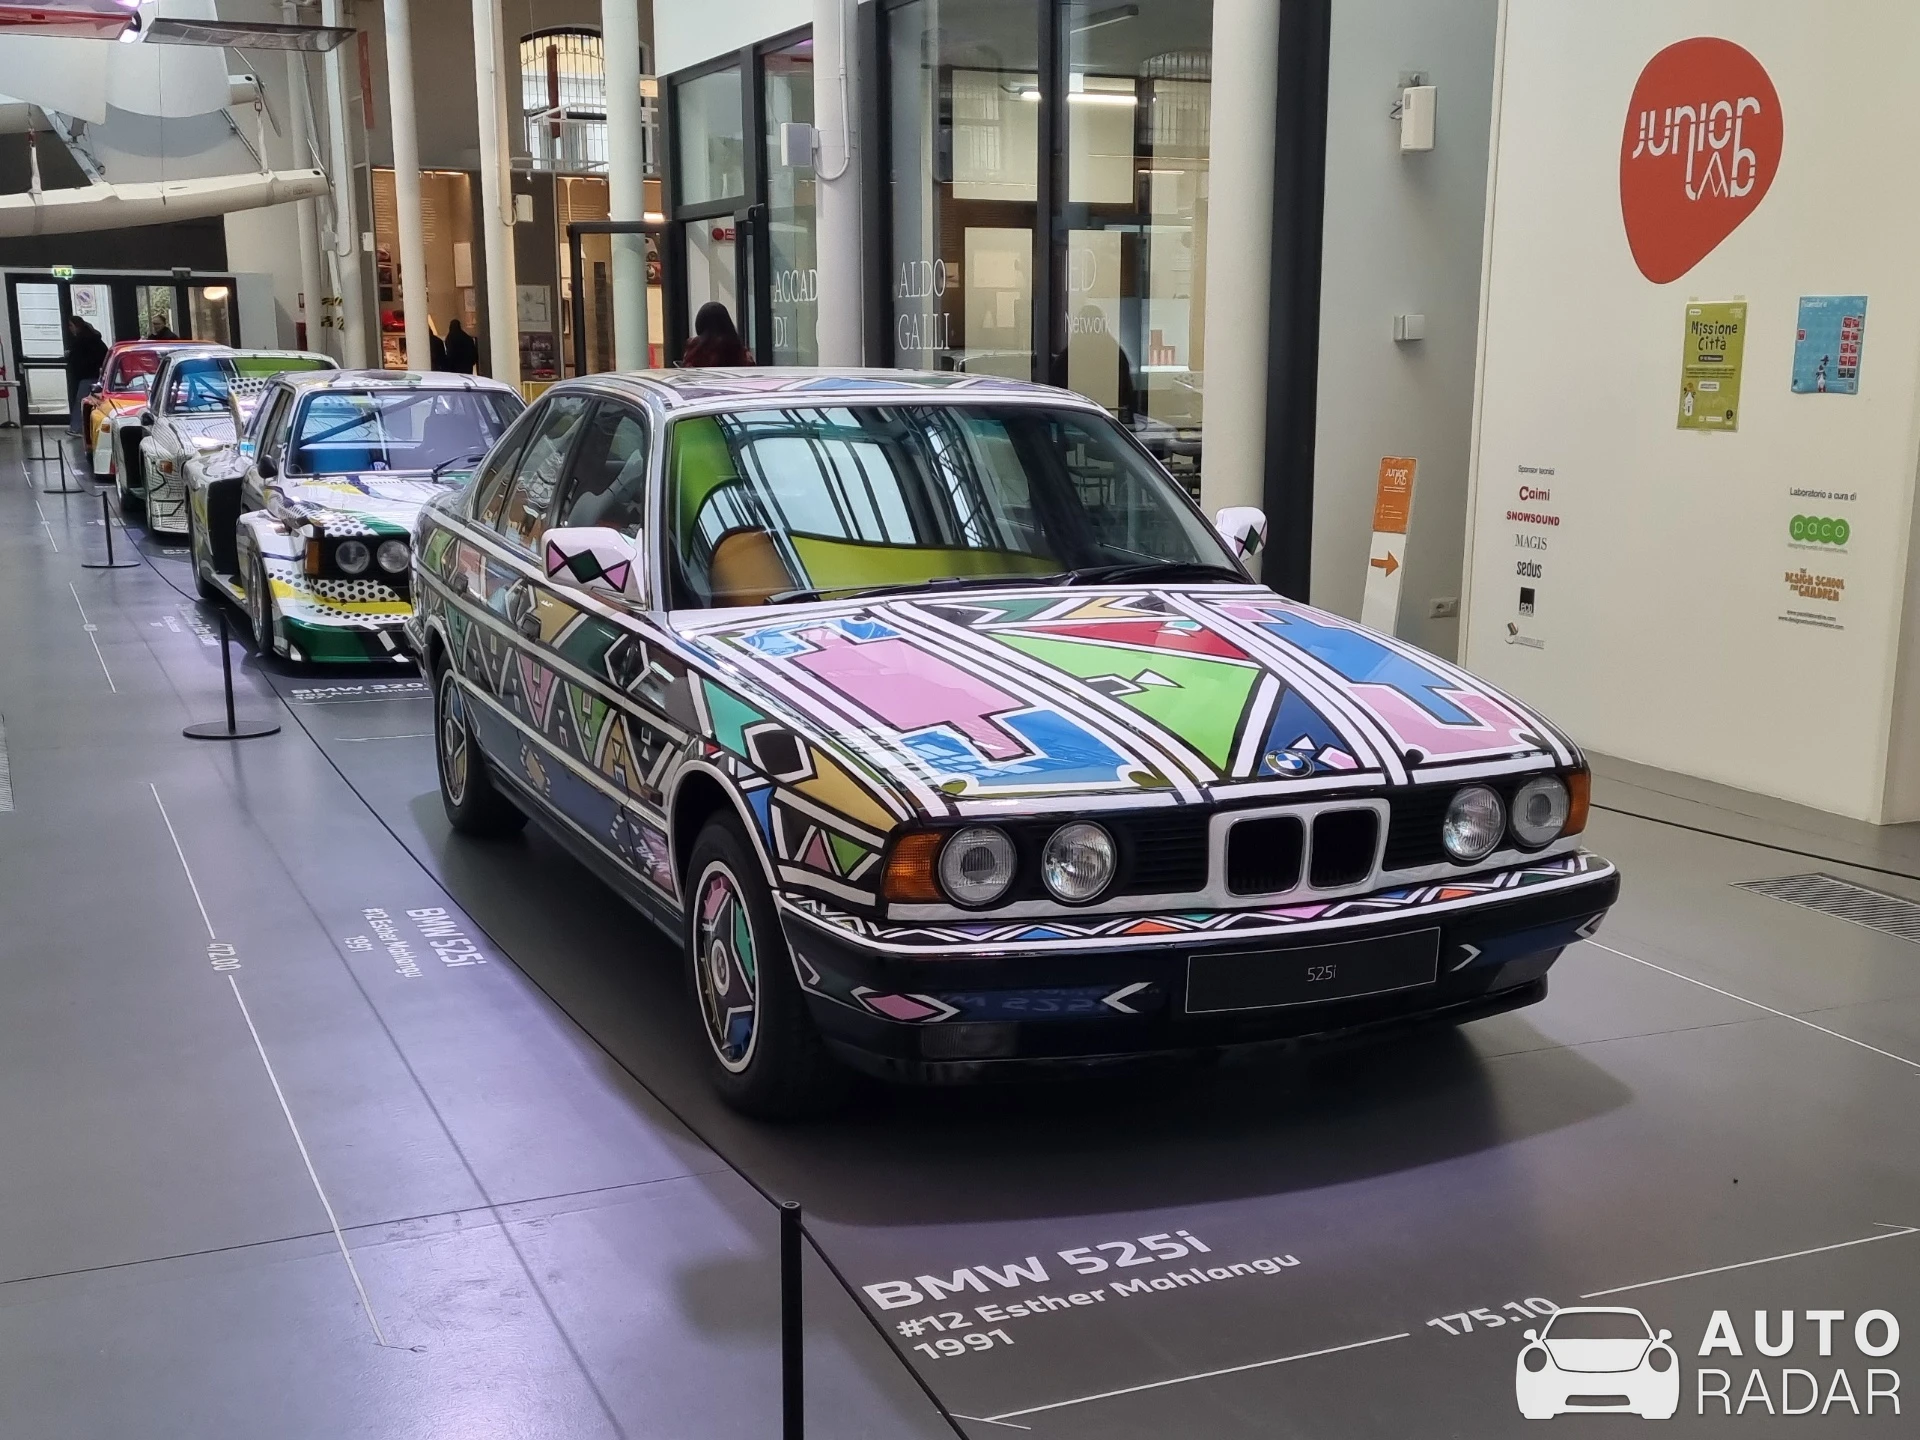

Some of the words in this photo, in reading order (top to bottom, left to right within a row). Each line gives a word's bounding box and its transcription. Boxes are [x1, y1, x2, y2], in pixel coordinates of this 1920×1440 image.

[898, 258, 946, 298] ALDO
[774, 316, 789, 347] DI
[898, 312, 950, 350] GALLI
[1064, 311, 1112, 335] Network
[1691, 320, 1738, 336] Missione
[1698, 336, 1727, 351] Città
[1519, 486, 1550, 501] Caimi
[1789, 487, 1826, 499] Laboratorio
[1834, 492, 1848, 500] cura
[1850, 492, 1857, 501] di
[1506, 510, 1560, 526] SNOWSOUND
[1794, 521, 1845, 538] paco
[1515, 534, 1547, 551] MAGIS
[1517, 559, 1542, 579] sedus
[368, 919, 399, 941] Esther
[405, 907, 465, 938] BMW
[343, 935, 374, 953] 1991
[429, 938, 487, 967] 525i
[1307, 964, 1337, 982] 525i
[862, 1256, 1051, 1312] BMW
[1057, 1230, 1212, 1275] 525i
[896, 1310, 973, 1339] #12
[974, 1287, 1110, 1323] Esther
[1109, 1252, 1301, 1298] Mahlangu
[1426, 1297, 1562, 1336] 175.10
[913, 1328, 1015, 1360] 1991
